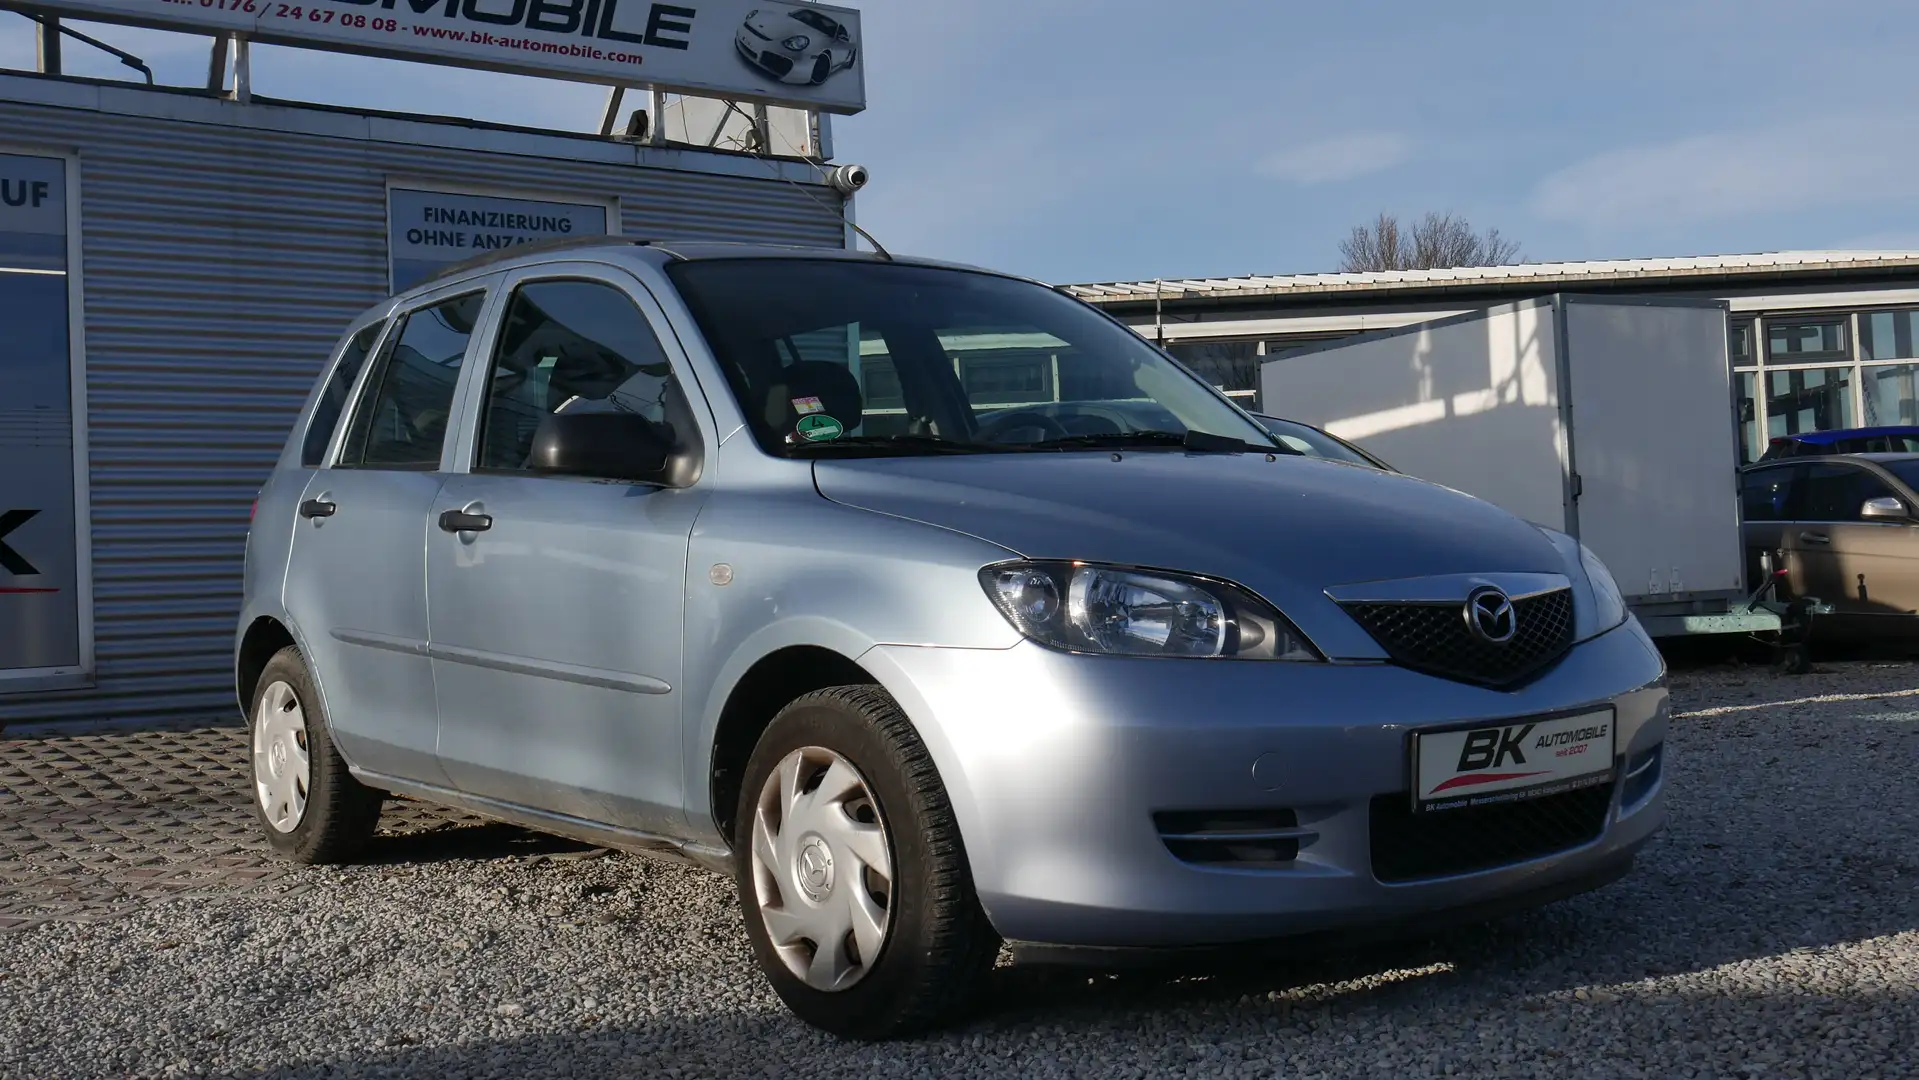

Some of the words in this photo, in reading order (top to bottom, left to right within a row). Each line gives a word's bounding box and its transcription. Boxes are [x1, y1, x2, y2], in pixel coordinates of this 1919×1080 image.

[276, 4, 303, 20] 24
[308, 9, 335, 24] 67
[340, 13, 367, 29] 08
[371, 17, 398, 33] 08
[412, 24, 644, 65] www.bk-automobile.com
[423, 206, 573, 234] FINANZIERUNG
[406, 228, 466, 248] OHNE
[470, 233, 540, 250] ANZA
[1456, 723, 1537, 773] BK
[1534, 724, 1608, 749] AUTOMOBILE
[1555, 749, 1568, 758] seit
[1568, 743, 1588, 757] 2007
[1425, 803, 1436, 812] BK
[1436, 799, 1468, 811] Automobile
